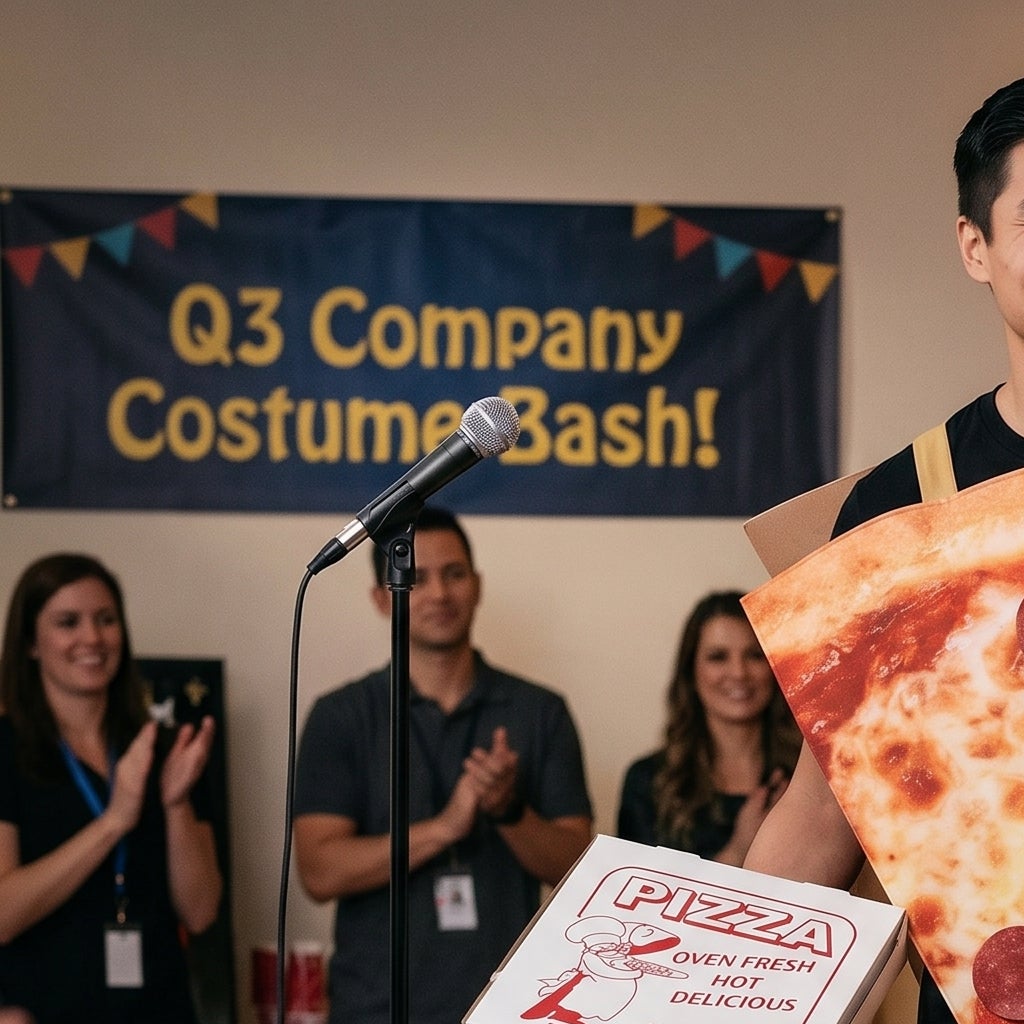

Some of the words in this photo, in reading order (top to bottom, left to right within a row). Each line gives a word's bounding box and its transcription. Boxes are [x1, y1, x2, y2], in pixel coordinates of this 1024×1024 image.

[171, 283, 284, 366] Q3
[310, 287, 683, 374] Company
[107, 378, 465, 463] Costume
[499, 386, 720, 468] Bash!
[613, 876, 833, 958] PIZZA
[673, 950, 737, 968] OVEN
[740, 957, 817, 974] FRESH
[711, 974, 764, 990] HOT
[670, 991, 798, 1012] DELICIOUS
